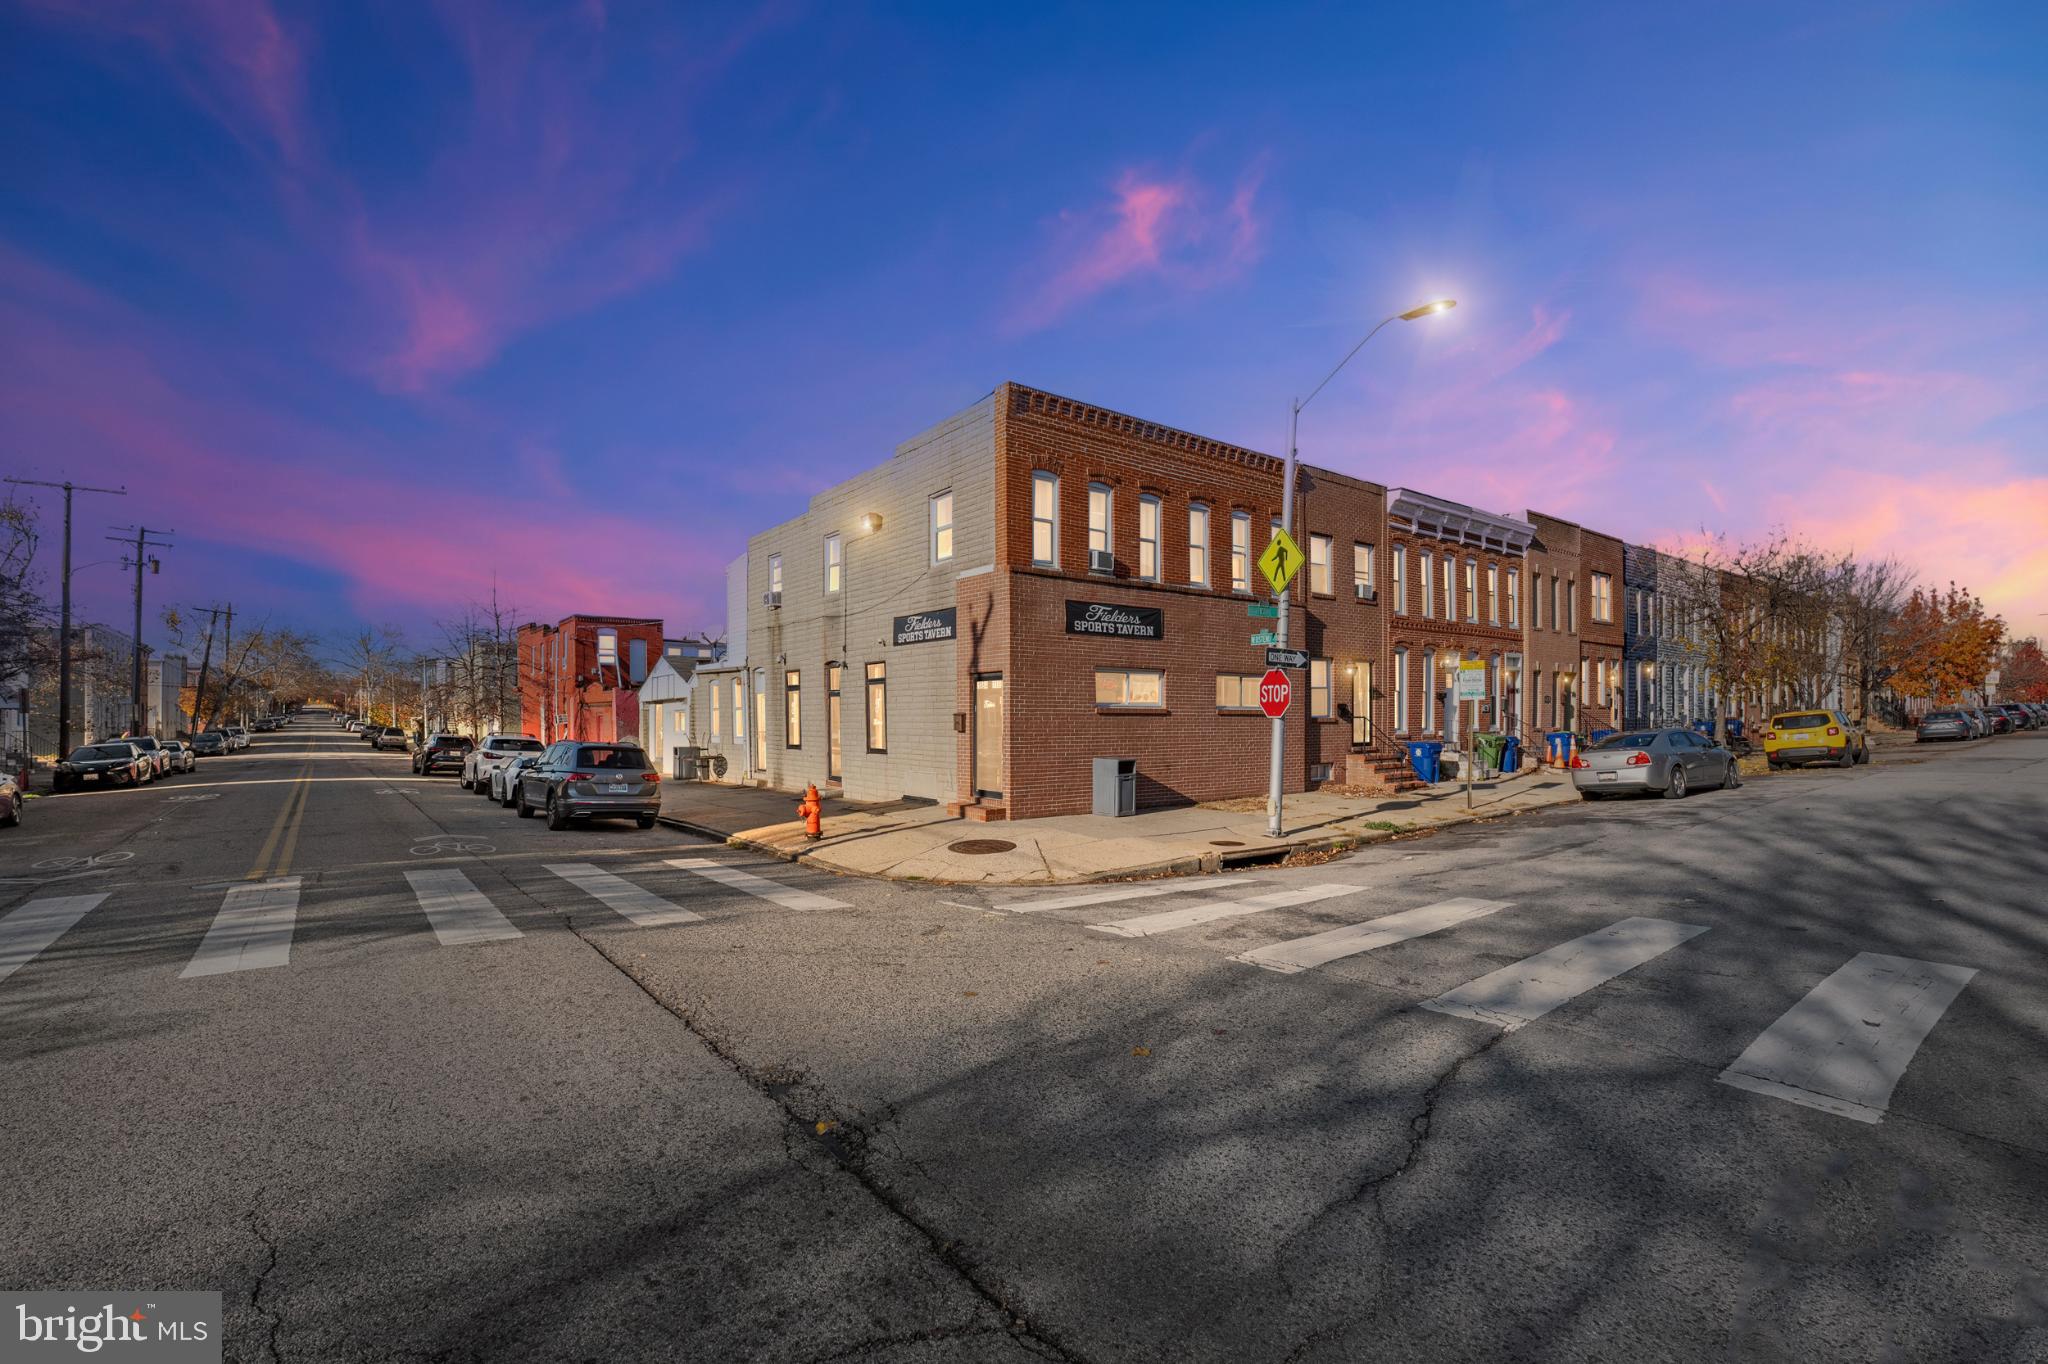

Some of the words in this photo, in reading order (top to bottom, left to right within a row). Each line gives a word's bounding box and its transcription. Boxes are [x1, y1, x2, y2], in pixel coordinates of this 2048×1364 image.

[1085, 604, 1141, 624] Fielders
[904, 616, 942, 632] Fielders
[1074, 620, 1115, 633] SPORTS
[1116, 623, 1154, 636] TAVERN
[897, 630, 923, 643] SPORTS
[924, 625, 951, 640] TAVERN
[1270, 653, 1283, 661] ONE
[1284, 654, 1297, 662] WAY
[1261, 685, 1288, 703] STOP
